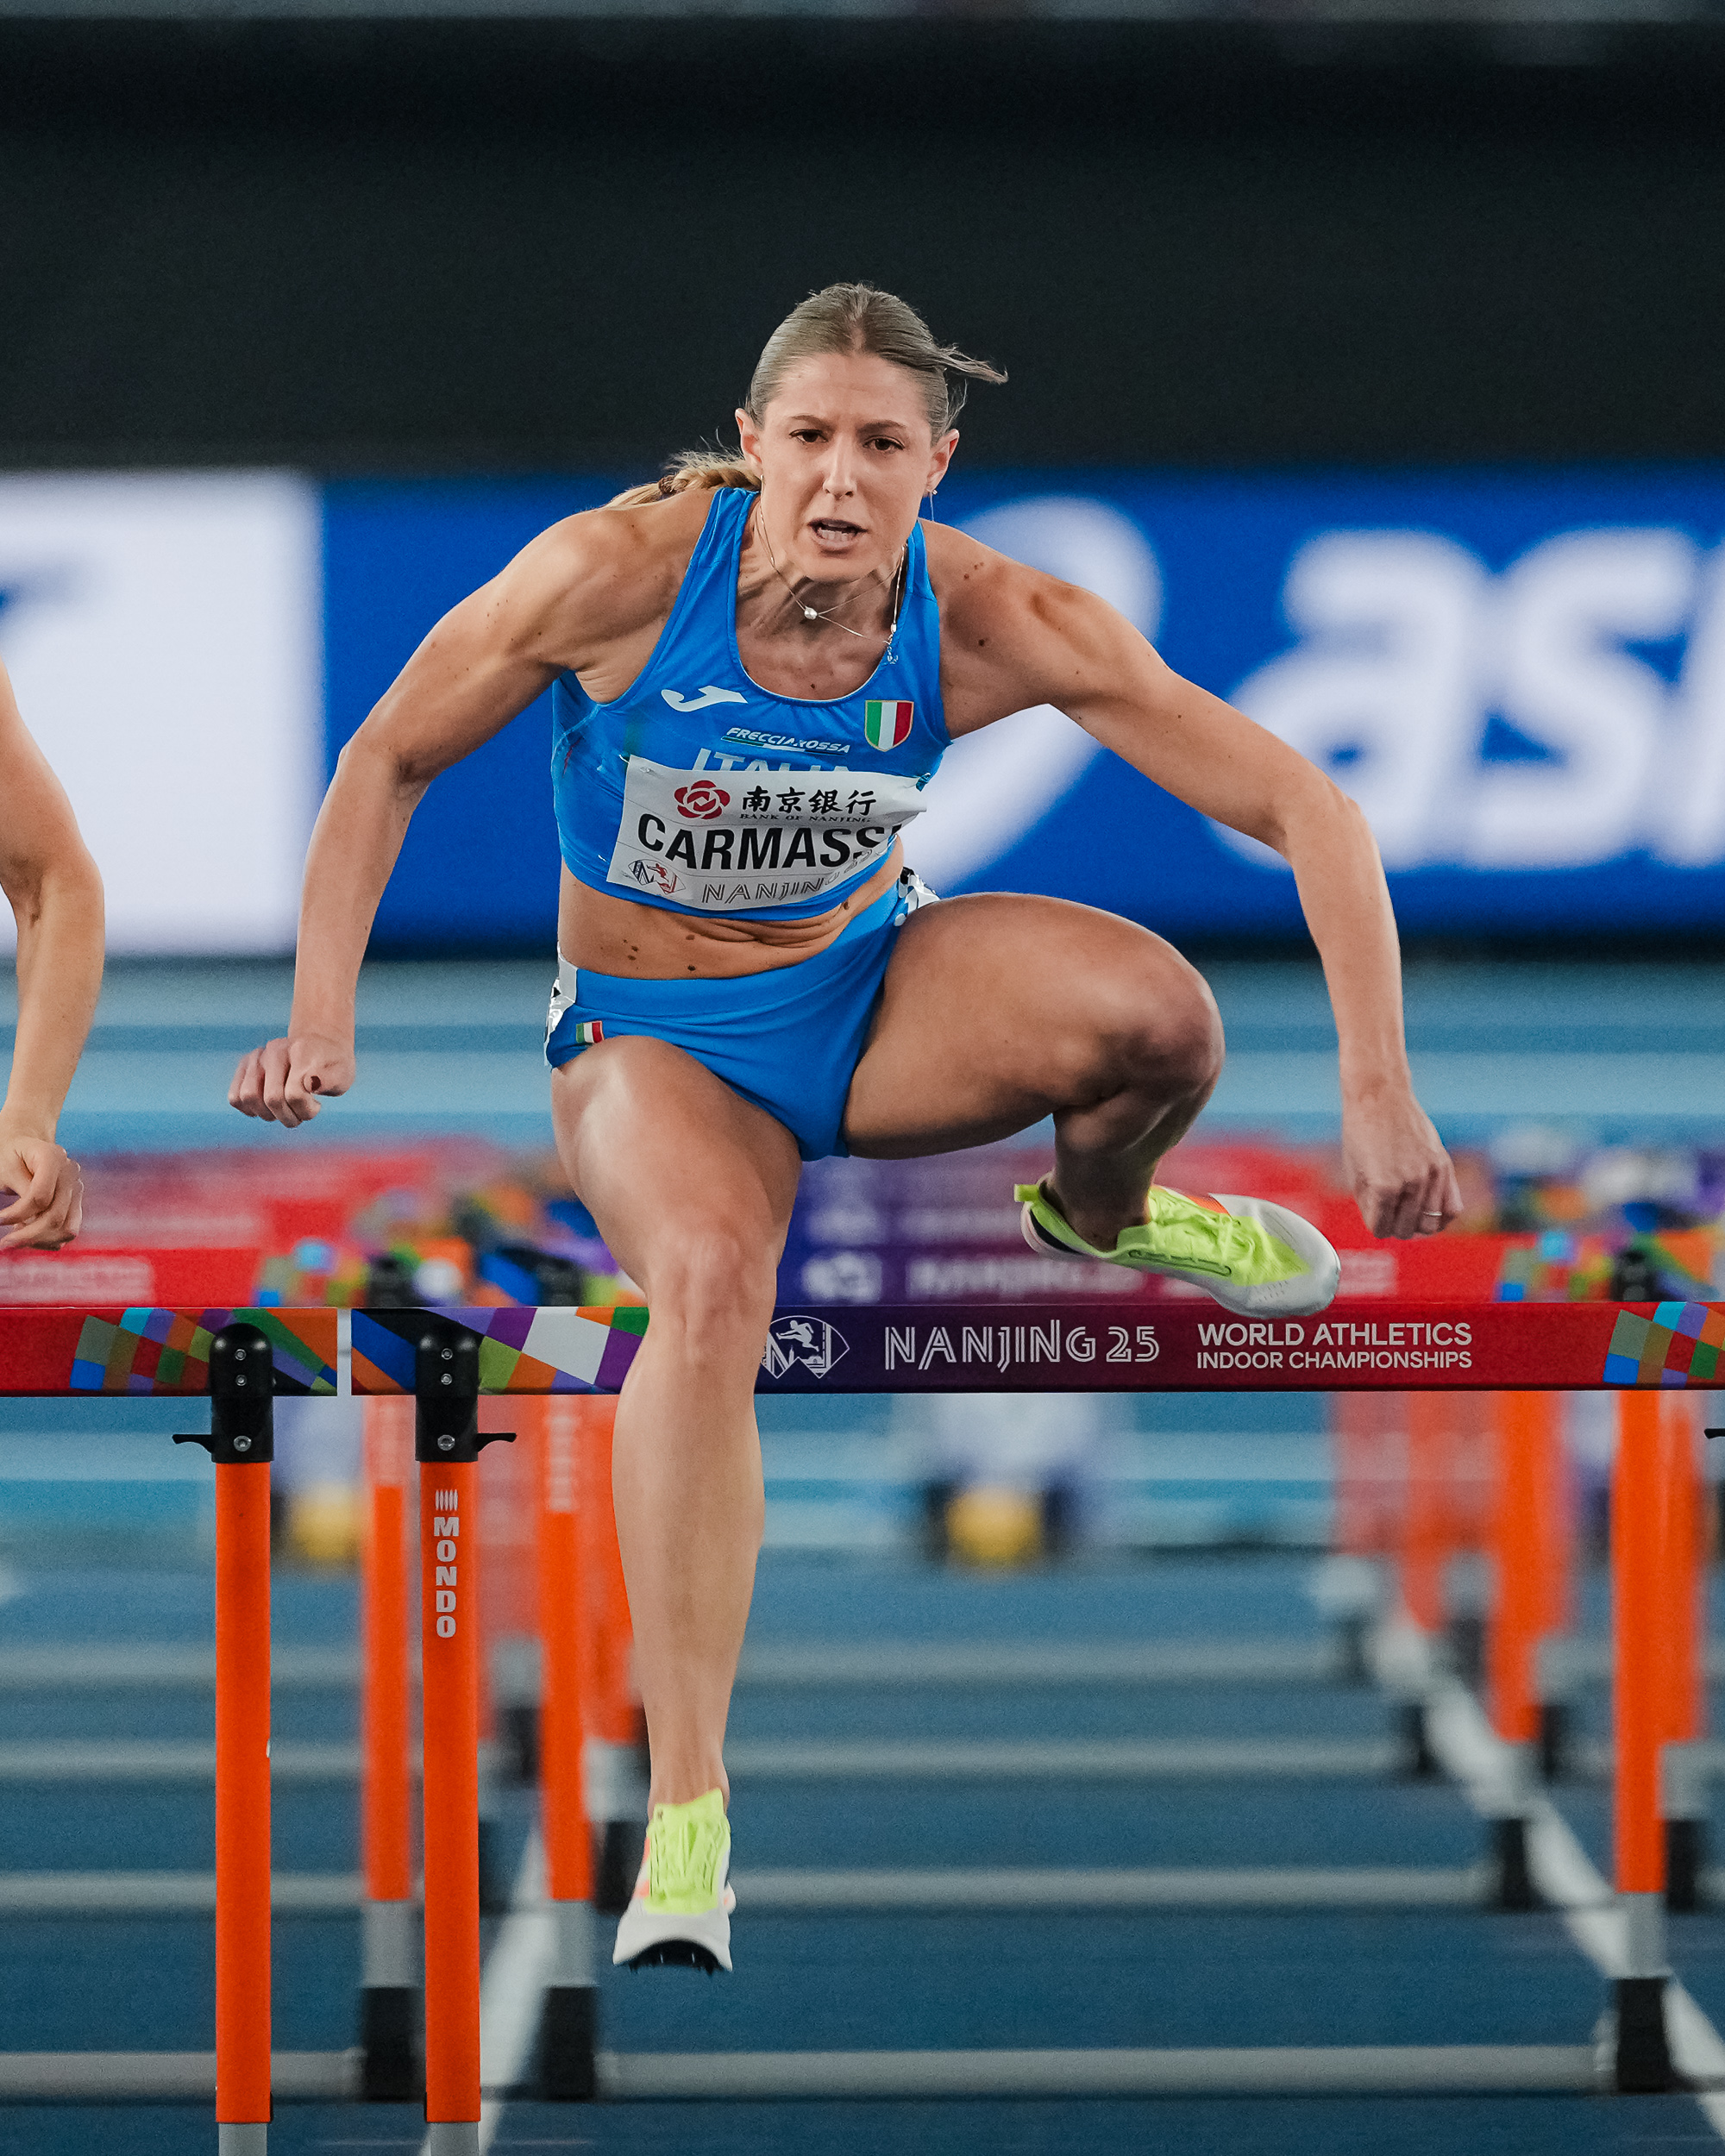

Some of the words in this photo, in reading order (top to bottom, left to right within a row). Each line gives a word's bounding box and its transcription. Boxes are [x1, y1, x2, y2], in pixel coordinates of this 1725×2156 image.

[637, 813, 902, 869] CARMASS
[885, 1319, 1096, 1372] NANJING
[1106, 1326, 1160, 1363] 25
[1197, 1323, 1305, 1346] WORLD
[1312, 1322, 1472, 1345] ATHLETICS
[1197, 1351, 1283, 1369] INDOOR
[1289, 1351, 1472, 1369] CHAMPIONSHIPS
[434, 1516, 460, 1639] MONDO
